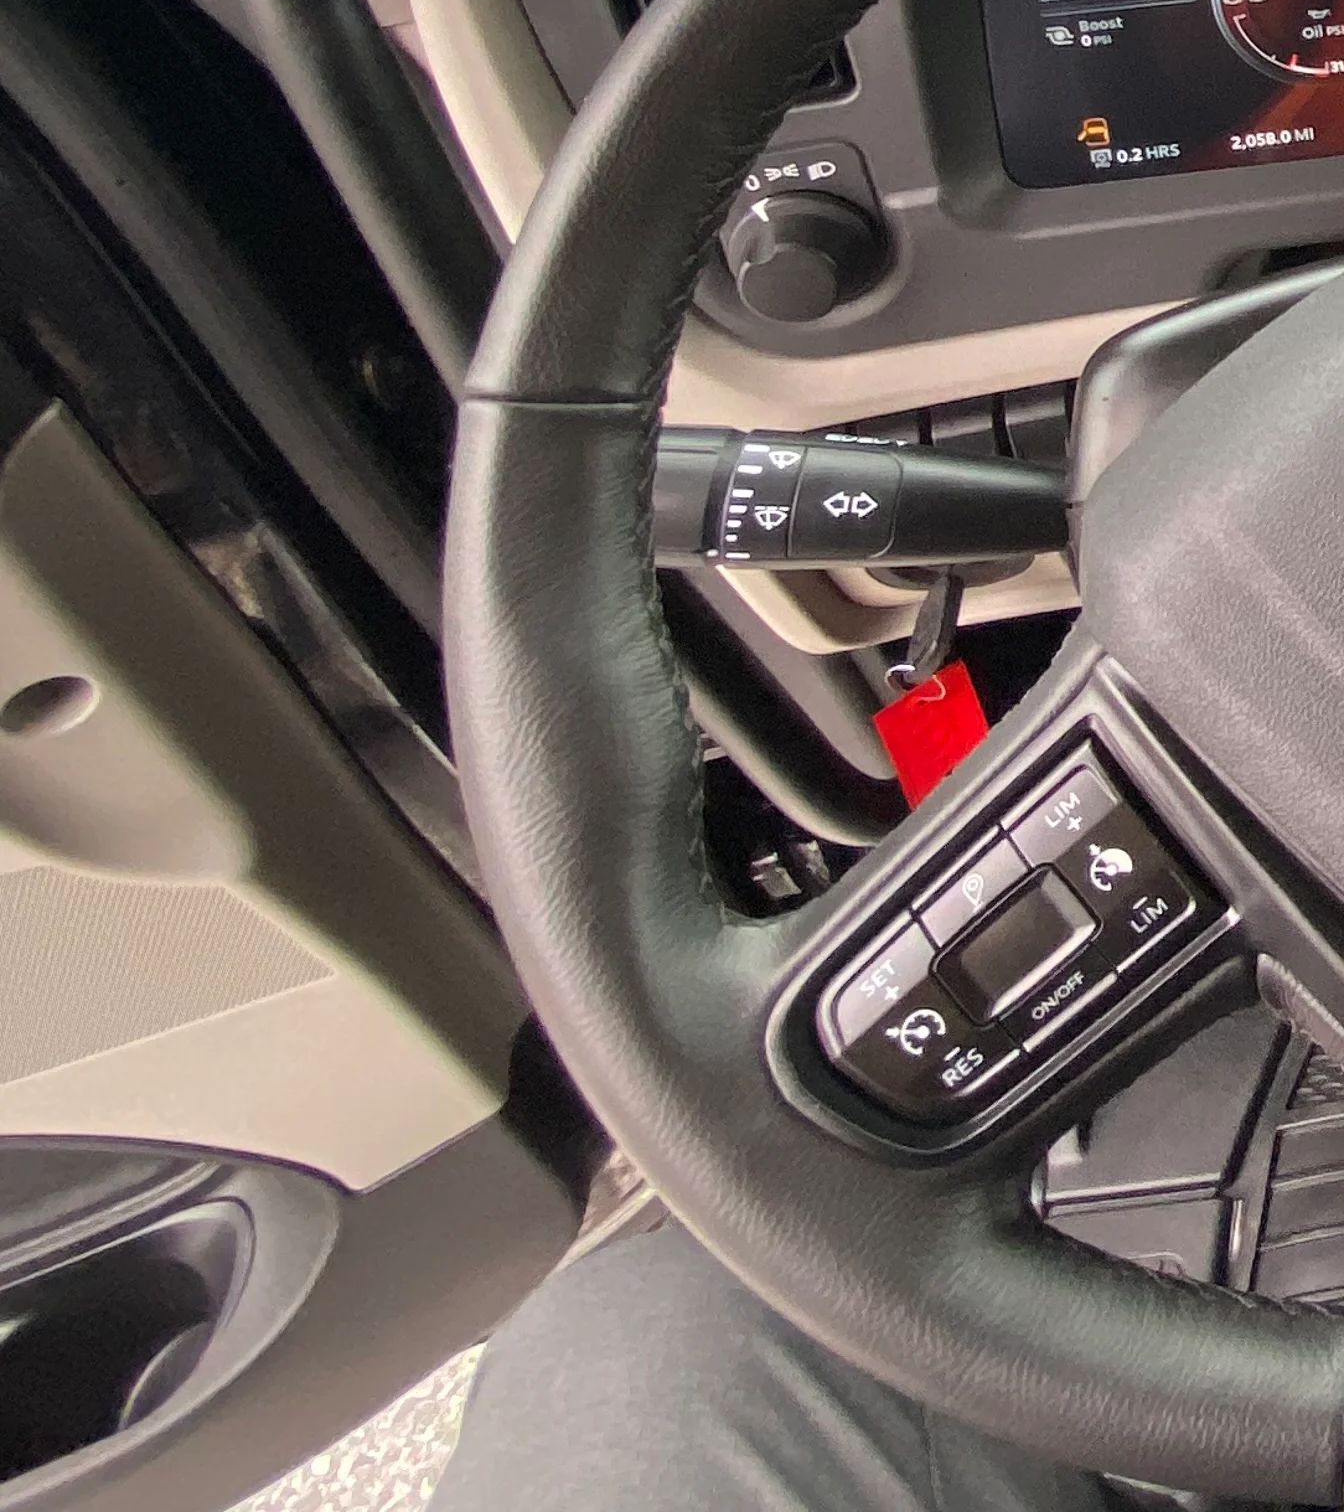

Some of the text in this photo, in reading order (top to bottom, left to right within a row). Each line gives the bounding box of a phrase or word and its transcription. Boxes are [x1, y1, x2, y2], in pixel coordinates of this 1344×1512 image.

[1079, 16, 1124, 32] Boost
[1302, 24, 1323, 40] Oil
[1116, 143, 1181, 163] 0.2 HRS
[1230, 128, 1314, 151] 2,058.0 MI
[1044, 791, 1082, 829] LIM
[1129, 897, 1169, 935] LIM
[860, 958, 897, 999] SET
[1030, 970, 1086, 1022] ON/OFF
[941, 1046, 985, 1088] RES
